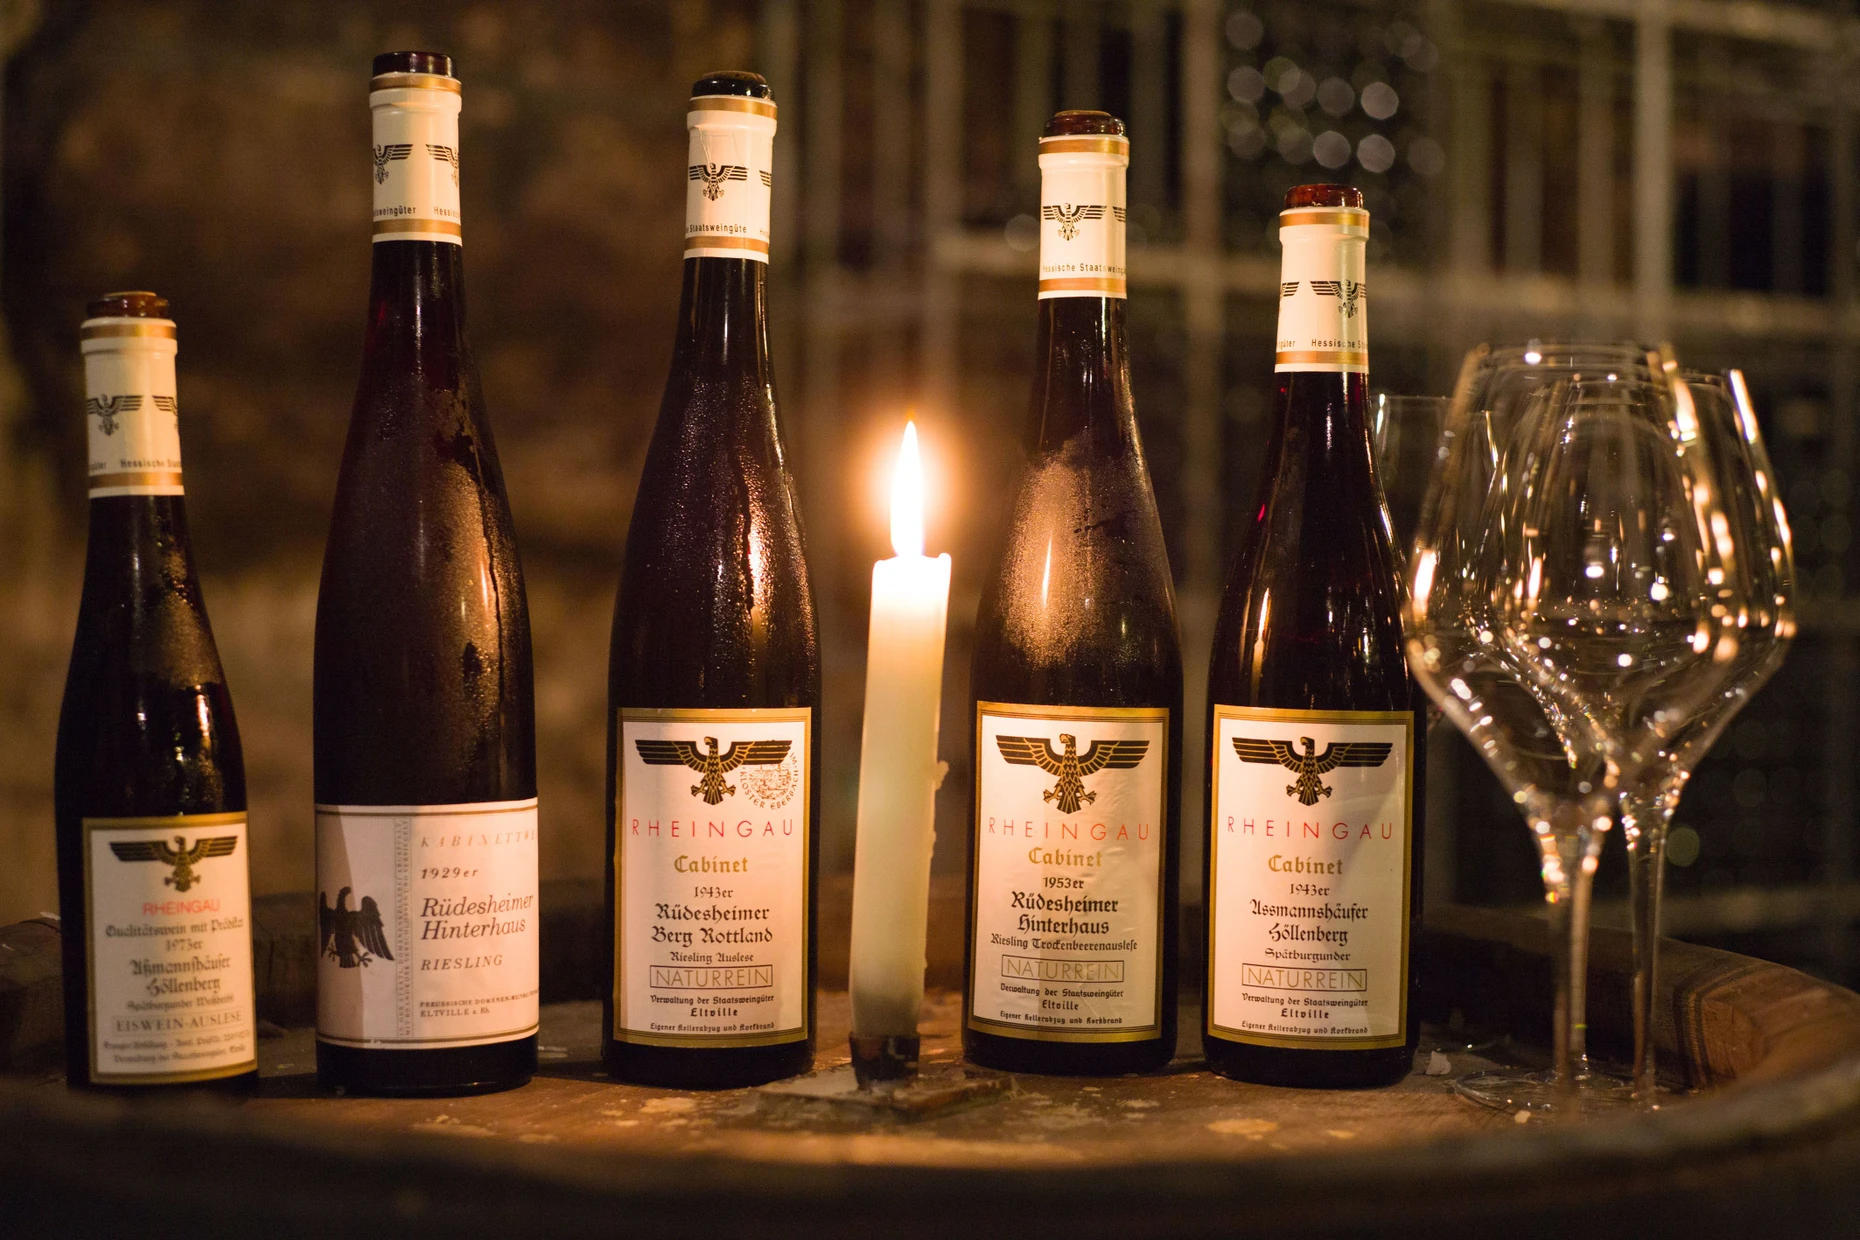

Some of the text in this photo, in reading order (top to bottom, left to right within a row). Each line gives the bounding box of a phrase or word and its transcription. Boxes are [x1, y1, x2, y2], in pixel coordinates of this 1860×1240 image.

[1311, 338, 1355, 348] Hessische
[740, 769, 799, 810] KLOSTER EBERBACH
[632, 818, 793, 838] RHEINGAU
[988, 817, 1149, 841] RHEINGAU
[1228, 816, 1392, 840] RHEINGAU
[673, 854, 749, 874] Cabinet
[1028, 846, 1102, 867] Cabinet
[1268, 854, 1343, 875] Cabinet
[421, 867, 478, 879] 1929er
[1043, 876, 1085, 889] 1953er
[1290, 883, 1330, 896] 1943er
[694, 886, 734, 898] 1943er
[142, 899, 220, 916] RHEINGAU
[420, 892, 534, 918] Rüdesheimer
[1010, 890, 1119, 915] Rüdesheimer
[654, 902, 770, 924] Rüdesheimer
[191, 920, 209, 933] mit
[420, 917, 526, 940] Hinterhaus
[1017, 914, 1110, 935] Hinterhaus
[651, 925, 773, 948] Berg Rottland
[990, 933, 1028, 950] Riesling
[1268, 922, 1349, 946] Höllenberg
[420, 954, 503, 971] RIESLING
[669, 951, 754, 965] Riesling Auslese
[1264, 947, 1351, 963] Spätburgunder
[656, 968, 769, 988] NATURREIN
[1007, 958, 1119, 981] NATURREIN
[1247, 967, 1363, 989] NATURREIN
[146, 976, 221, 998] Höllenberg
[1000, 983, 1124, 999] Verwaltung der Staatsweingüter
[650, 994, 775, 1006] Verwaltung der Staatsweingüter
[1042, 999, 1079, 1011] Eltville
[1241, 993, 1368, 1008] Verwaltung der Staatsweingüter
[420, 1008, 470, 1018] ELTVILLE
[690, 1007, 739, 1017] Eltville
[1000, 1010, 1021, 1020] Eigener
[1280, 1008, 1330, 1019] Eltville
[116, 1010, 242, 1032] EISWEIN-AUSLESE
[650, 1022, 676, 1031] Eigener
[1241, 1020, 1266, 1030] Eigener
[1314, 1026, 1328, 1034] und
